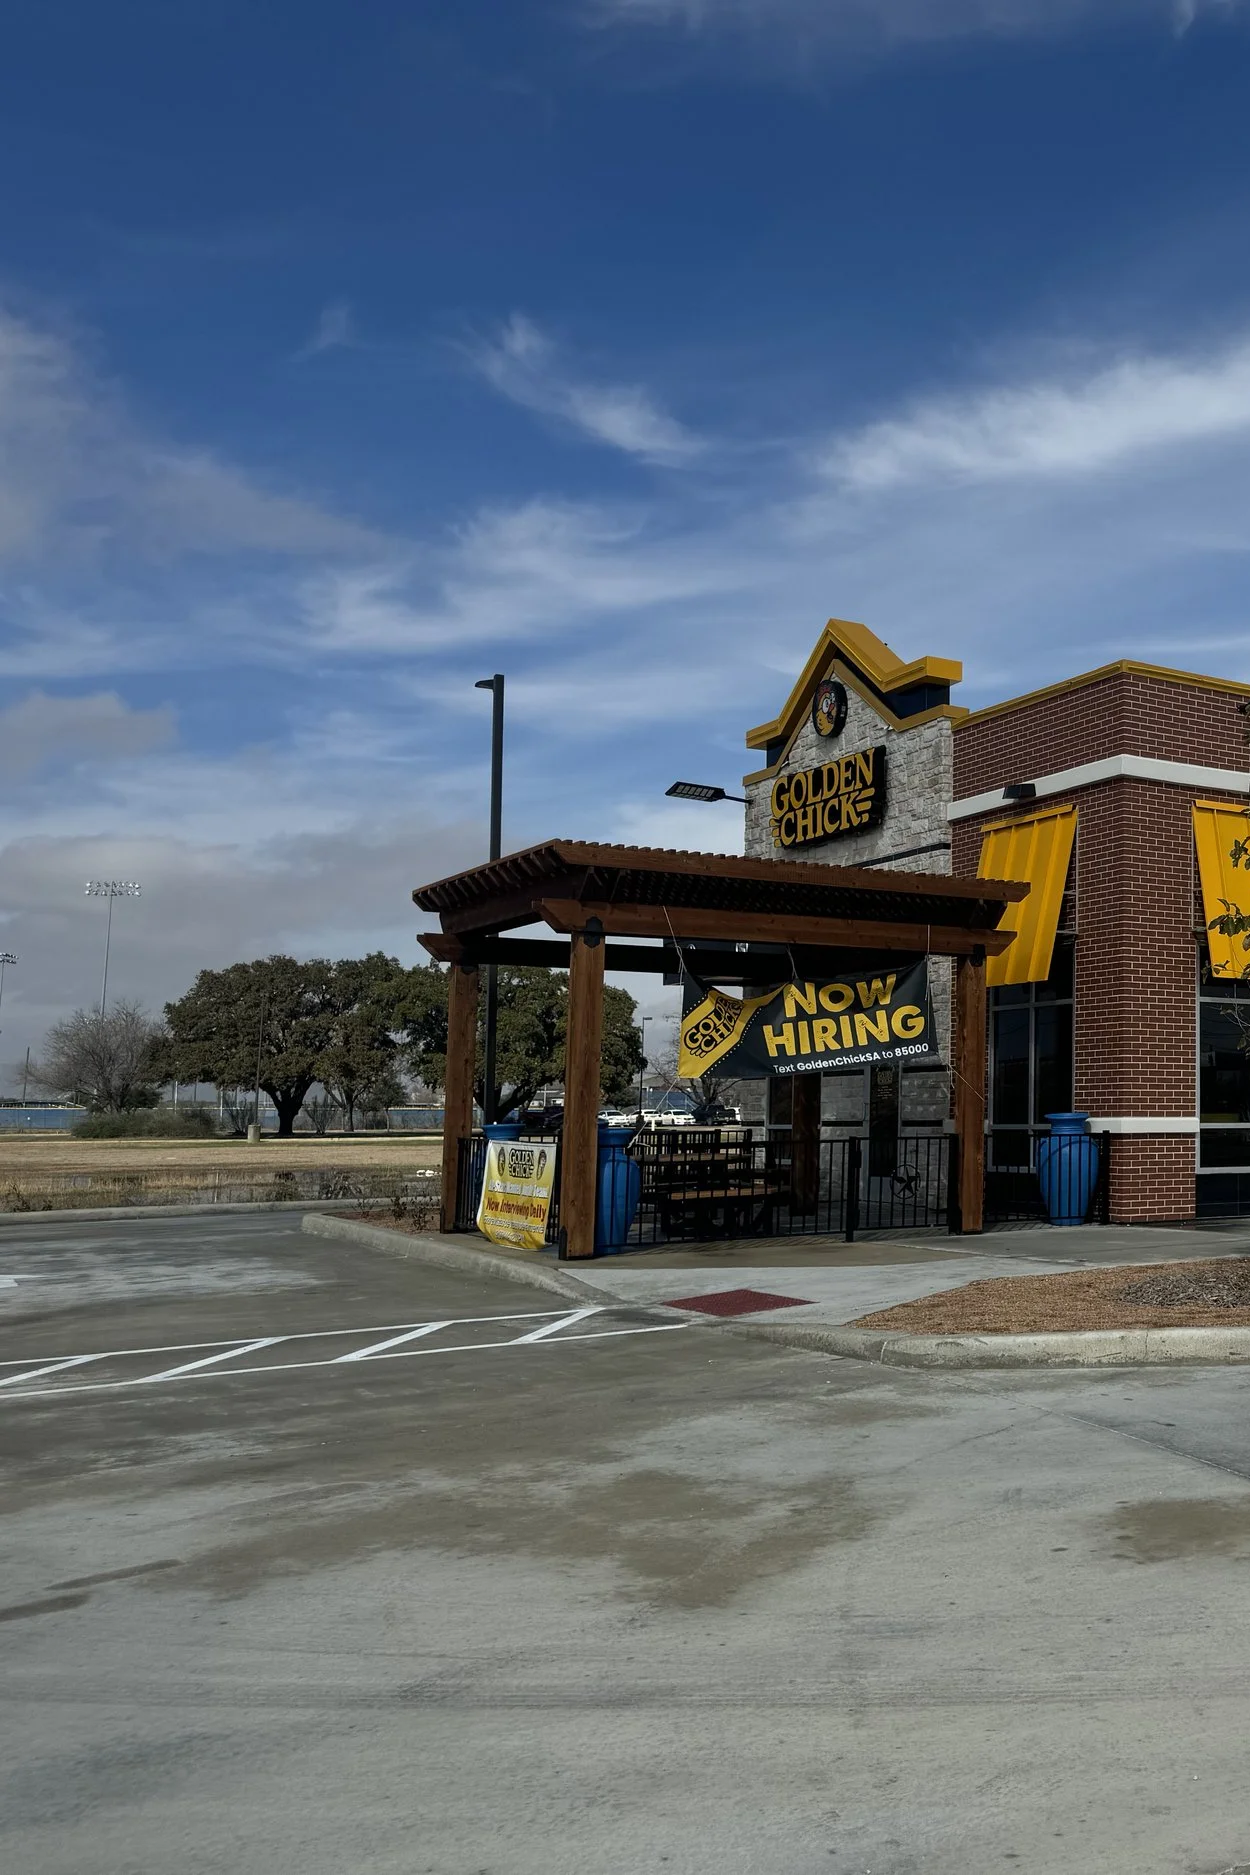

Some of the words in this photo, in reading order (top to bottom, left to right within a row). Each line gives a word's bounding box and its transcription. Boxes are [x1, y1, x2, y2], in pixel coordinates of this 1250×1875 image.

[771, 748, 875, 818] GOLDEN
[780, 791, 861, 846] CHICK
[783, 974, 897, 1018] NOW
[763, 1005, 925, 1058] HIRING
[773, 1064, 795, 1075] Text
[796, 1052, 881, 1072] GoldenChickSA
[882, 1049, 894, 1059] to
[895, 1043, 929, 1057] 85000
[510, 1149, 534, 1166] GOLDEN
[511, 1164, 531, 1178] CHICK
